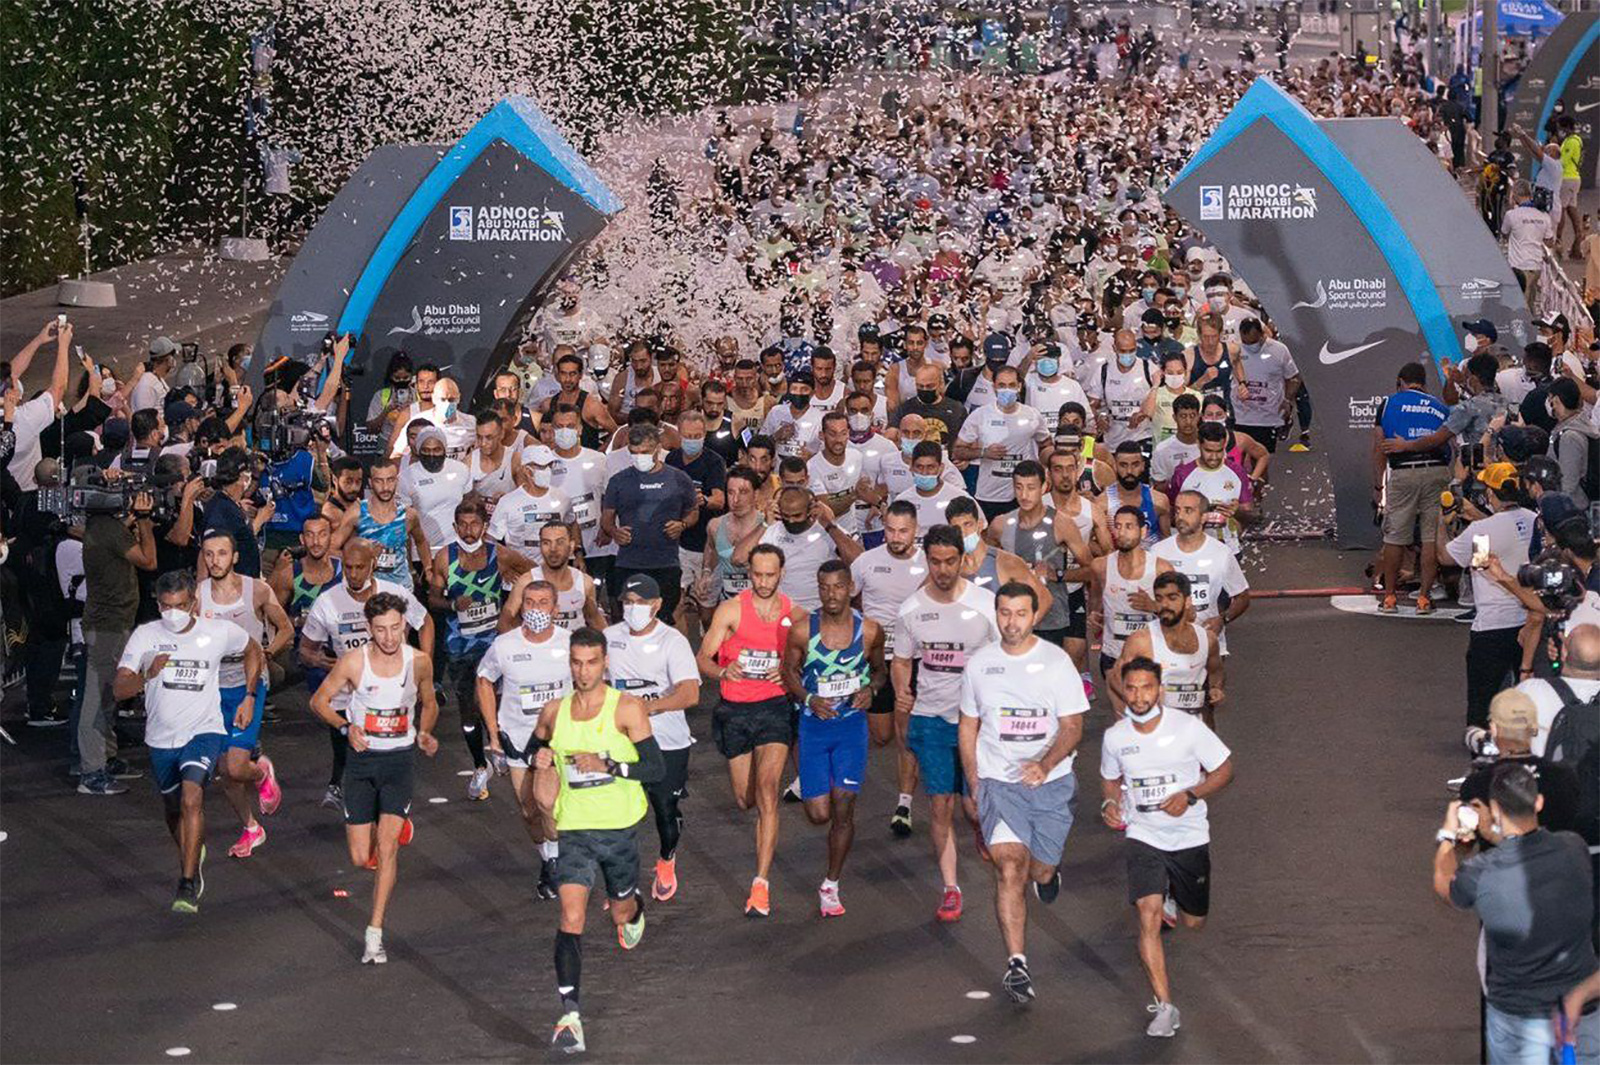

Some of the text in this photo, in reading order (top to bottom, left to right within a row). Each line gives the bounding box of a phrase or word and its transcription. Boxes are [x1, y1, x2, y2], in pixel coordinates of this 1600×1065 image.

[1228, 184, 1291, 198] ADNOC
[1228, 197, 1291, 207] ABU DHABI
[477, 206, 539, 220] ADNOC
[1228, 206, 1315, 219] MARATHON
[477, 220, 540, 229] ABU DHABI
[477, 229, 562, 241] MARATHON
[1328, 278, 1386, 290] Abu Dhabi
[1328, 290, 1386, 301] Sports Council
[424, 303, 480, 316] Abu Dhabi
[423, 315, 480, 326] Sports Council
[1401, 404, 1445, 420] PRODUCTION
[1193, 589, 1207, 599] 16
[344, 636, 374, 649] 102
[931, 653, 955, 663] 14049
[175, 669, 198, 678] 10339
[533, 692, 555, 702] 10345
